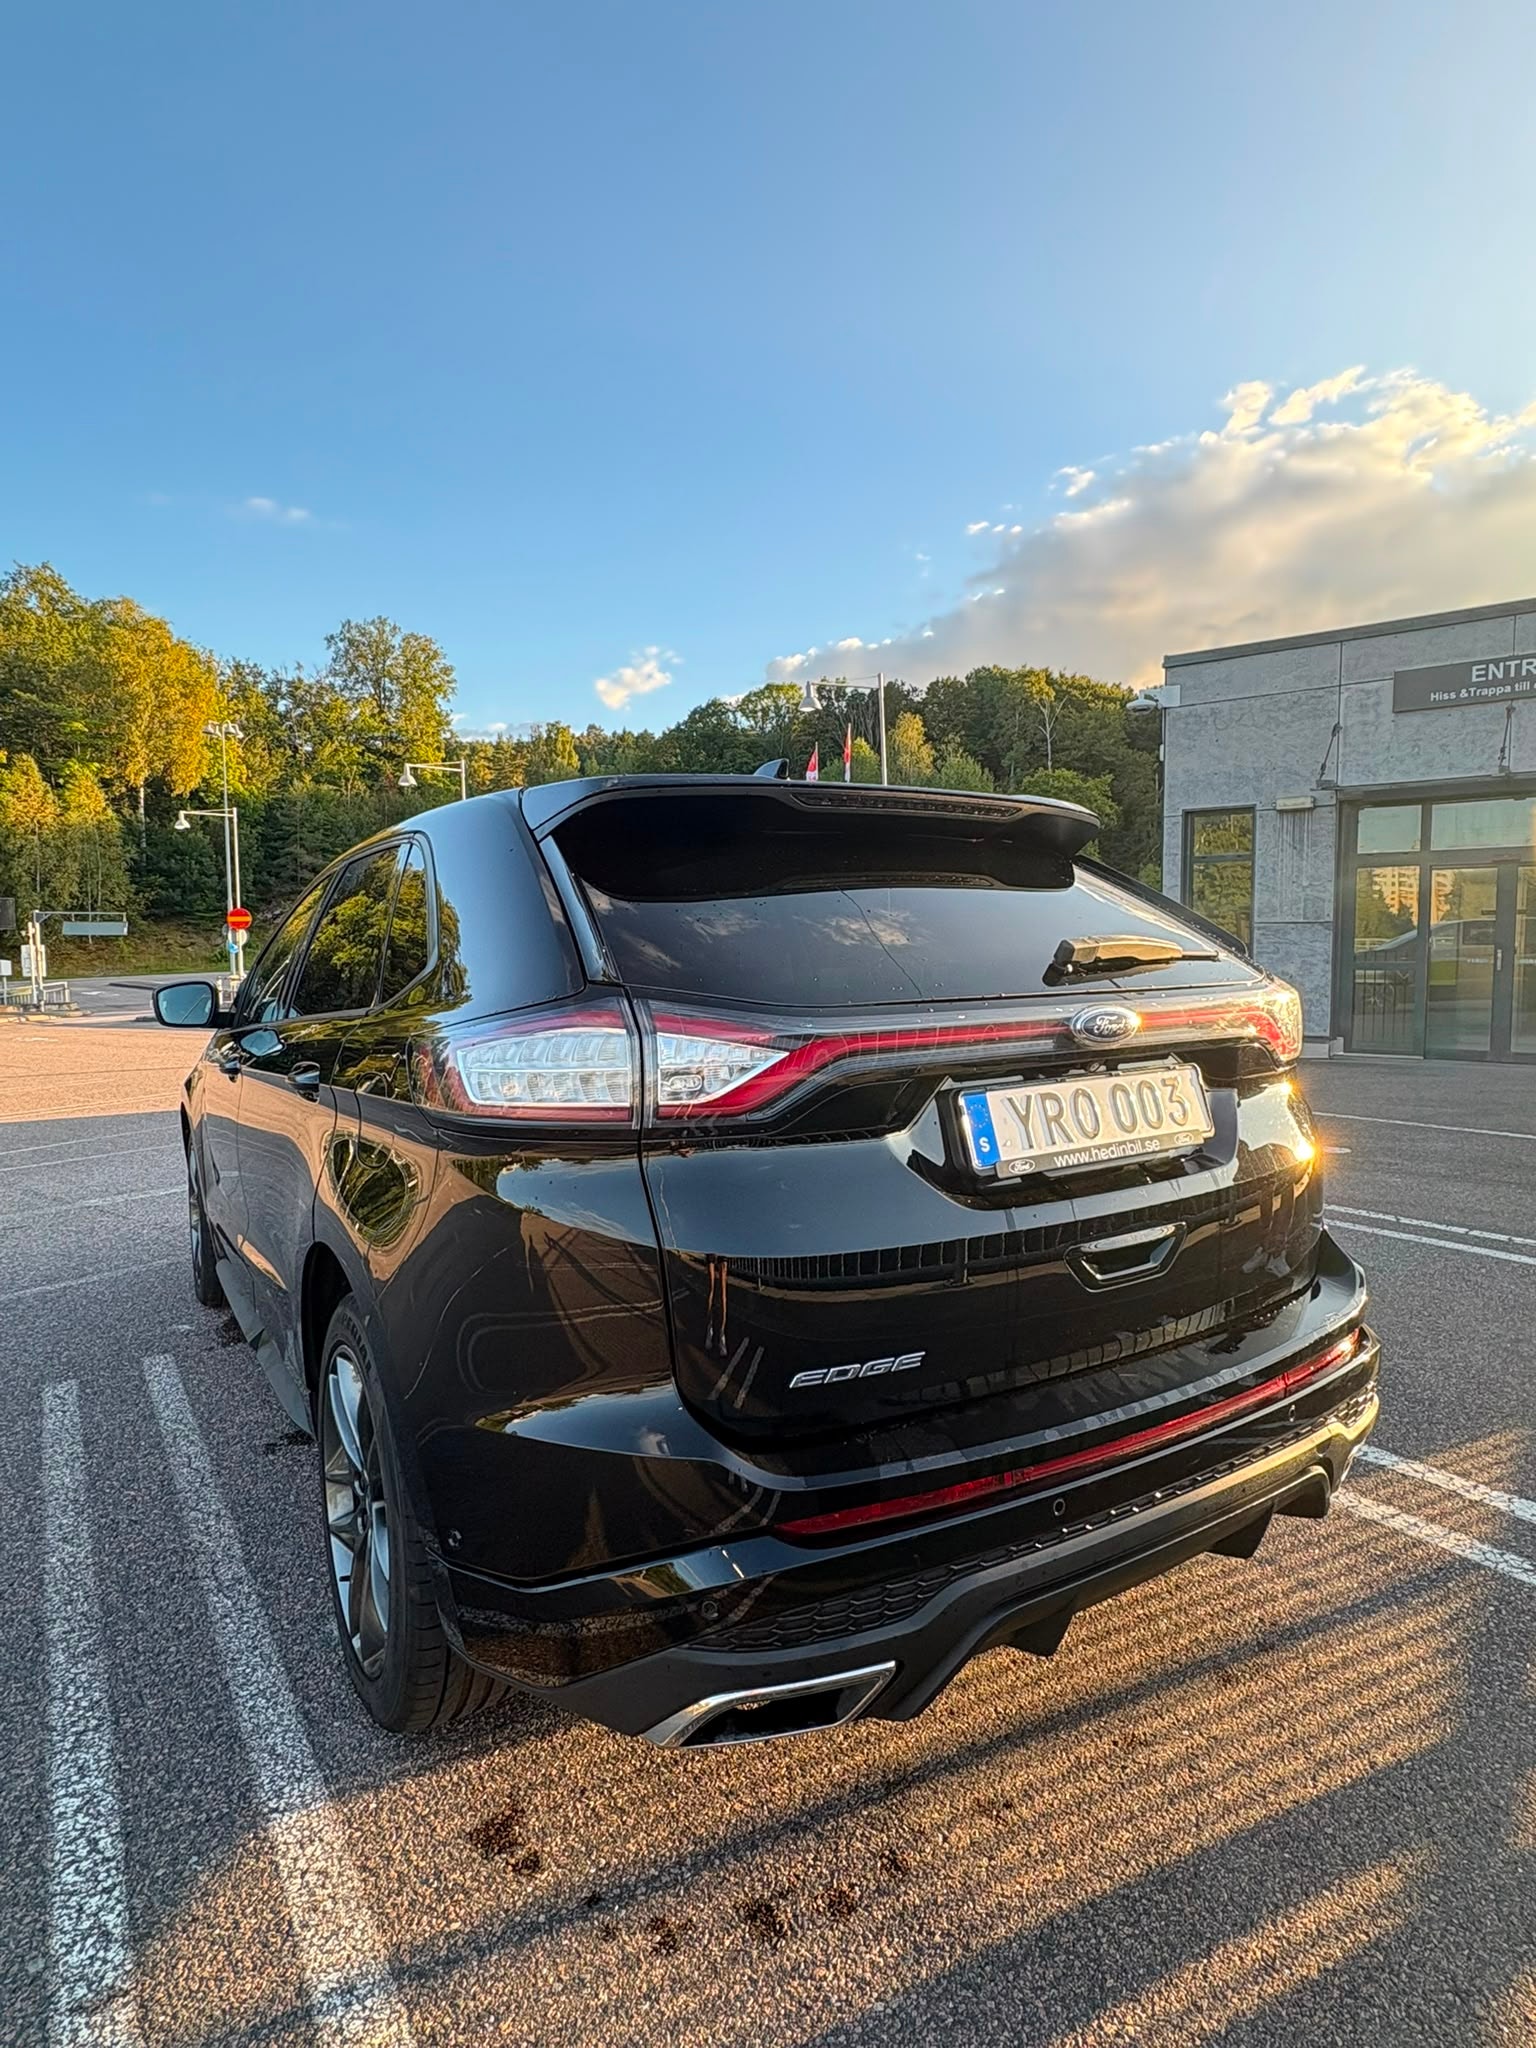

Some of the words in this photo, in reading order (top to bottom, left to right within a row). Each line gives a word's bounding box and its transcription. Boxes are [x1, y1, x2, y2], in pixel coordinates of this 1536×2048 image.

[1471, 658, 1536, 683] ENTR
[1430, 690, 1457, 702] Hiss
[1514, 681, 1530, 692] till
[1093, 1014, 1128, 1035] Ford
[1000, 1087, 1103, 1150] YRO
[1108, 1076, 1190, 1134] 003
[979, 1136, 991, 1153] S
[1053, 1139, 1161, 1168] www.hedinbil.se
[789, 1351, 926, 1389] EDGE
